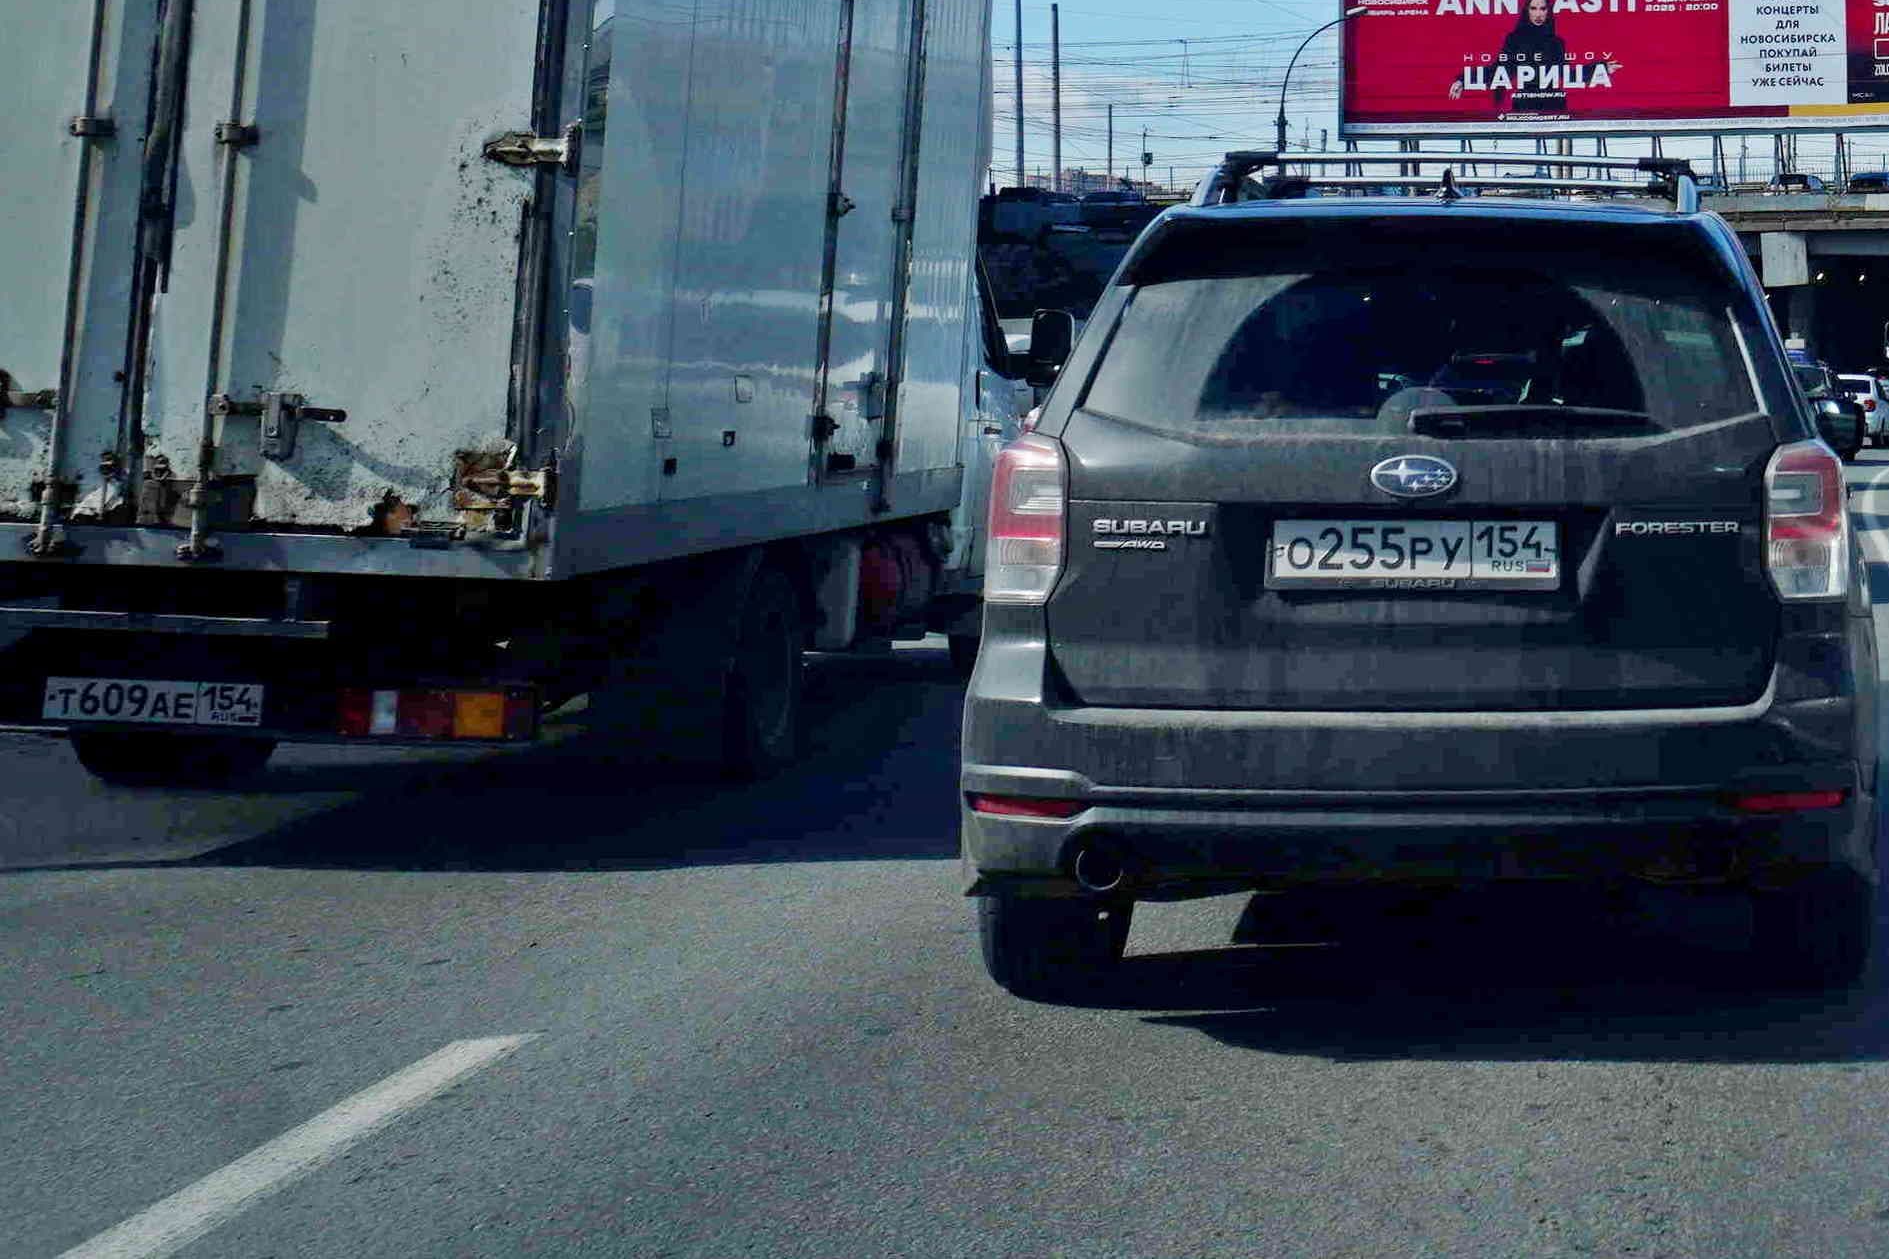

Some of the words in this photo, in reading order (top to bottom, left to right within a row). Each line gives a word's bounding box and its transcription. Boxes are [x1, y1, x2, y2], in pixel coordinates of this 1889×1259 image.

[1756, 5, 1819, 16] КОНЦЕРТЫ
[1775, 19, 1800, 29] ДЛЯ
[1740, 34, 1837, 44] НОВОСИБИРСКА
[1463, 52, 1543, 62] НОВОЕ
[1564, 51, 1614, 61] ШОУ
[1759, 46, 1817, 58] ПОКУПАЙ
[1765, 62, 1812, 72] БИЛЕТЫ
[1464, 63, 1612, 90] ЦАРИЦА
[1752, 77, 1776, 87] УЖЕ
[1779, 75, 1825, 87] СЕЙЧАС
[1093, 518, 1206, 534] SUBARU
[1615, 521, 1740, 535] FORESTER
[1119, 539, 1166, 549] AWD
[1287, 526, 1465, 572] О255РУ
[1475, 524, 1542, 559] 154
[1491, 559, 1525, 573] RUS
[57, 681, 195, 719] Т609АЕ
[202, 685, 251, 711] 154
